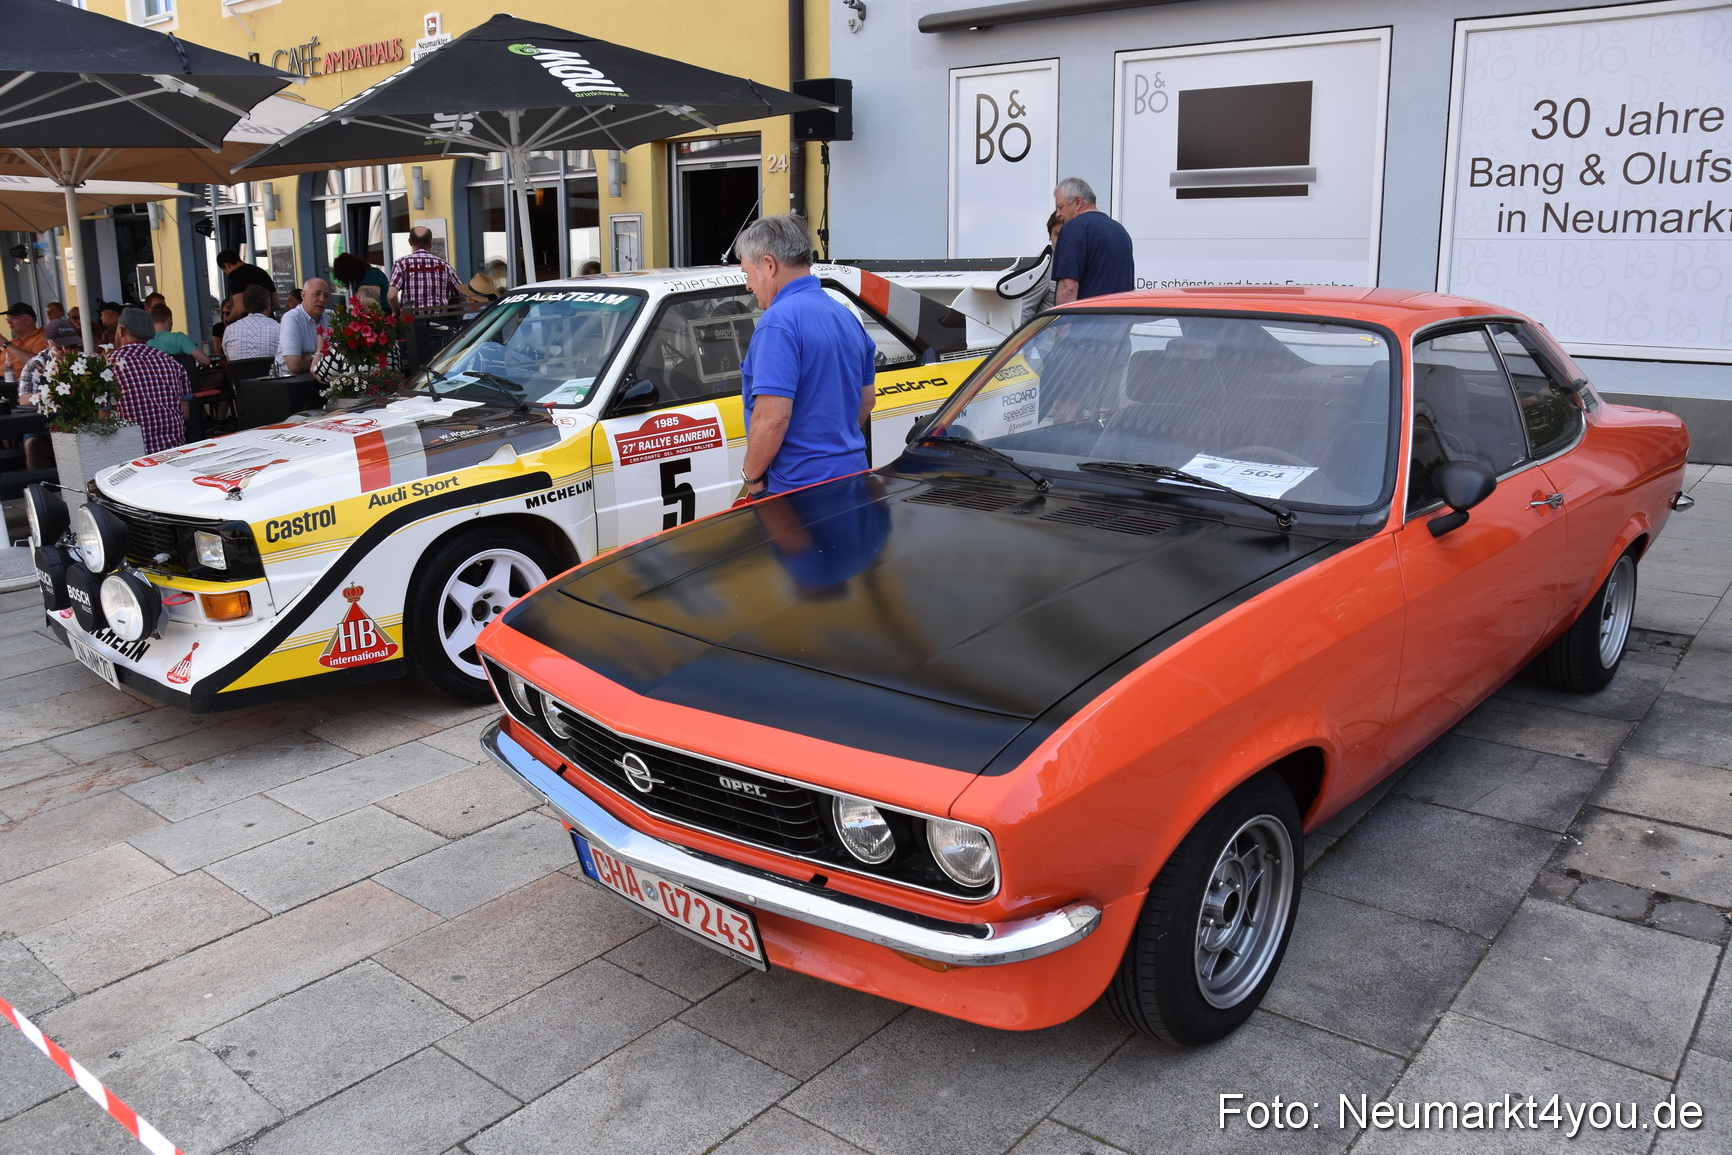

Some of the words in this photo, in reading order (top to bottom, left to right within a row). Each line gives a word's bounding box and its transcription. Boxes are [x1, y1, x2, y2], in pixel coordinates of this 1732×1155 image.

[418, 38, 448, 50] Neumarkter
[271, 36, 322, 77] CAFÉ
[323, 51, 344, 74] AM
[346, 37, 404, 69] RATHAUS
[1530, 97, 1591, 140] 30
[1605, 101, 1725, 138] Jahre
[768, 154, 788, 173] 24
[1469, 157, 1564, 195] Bang
[1578, 153, 1606, 186] &
[1497, 202, 1527, 234] in
[498, 294, 527, 306] HB
[563, 292, 629, 306] TEAM
[994, 364, 1030, 382] BOGE
[1002, 387, 1037, 407] RECARO
[654, 416, 680, 428] 1985
[638, 436, 671, 451] RALLYE
[673, 428, 716, 444] SANREMO
[630, 453, 660, 464] CAMPIONATO
[1240, 468, 1286, 479] 564
[368, 486, 407, 509] Audi
[411, 476, 460, 497] Sport
[525, 480, 592, 509] MICHELIN
[660, 458, 696, 531] 5
[266, 505, 336, 543] Castrol
[67, 584, 91, 606] BOSCH
[91, 626, 151, 663] CHELIN
[338, 618, 377, 653] HB
[330, 647, 388, 666] international
[174, 660, 191, 677] HB
[719, 776, 768, 798] OPEL
[592, 848, 644, 902] CHA
[658, 881, 754, 952] 07243
